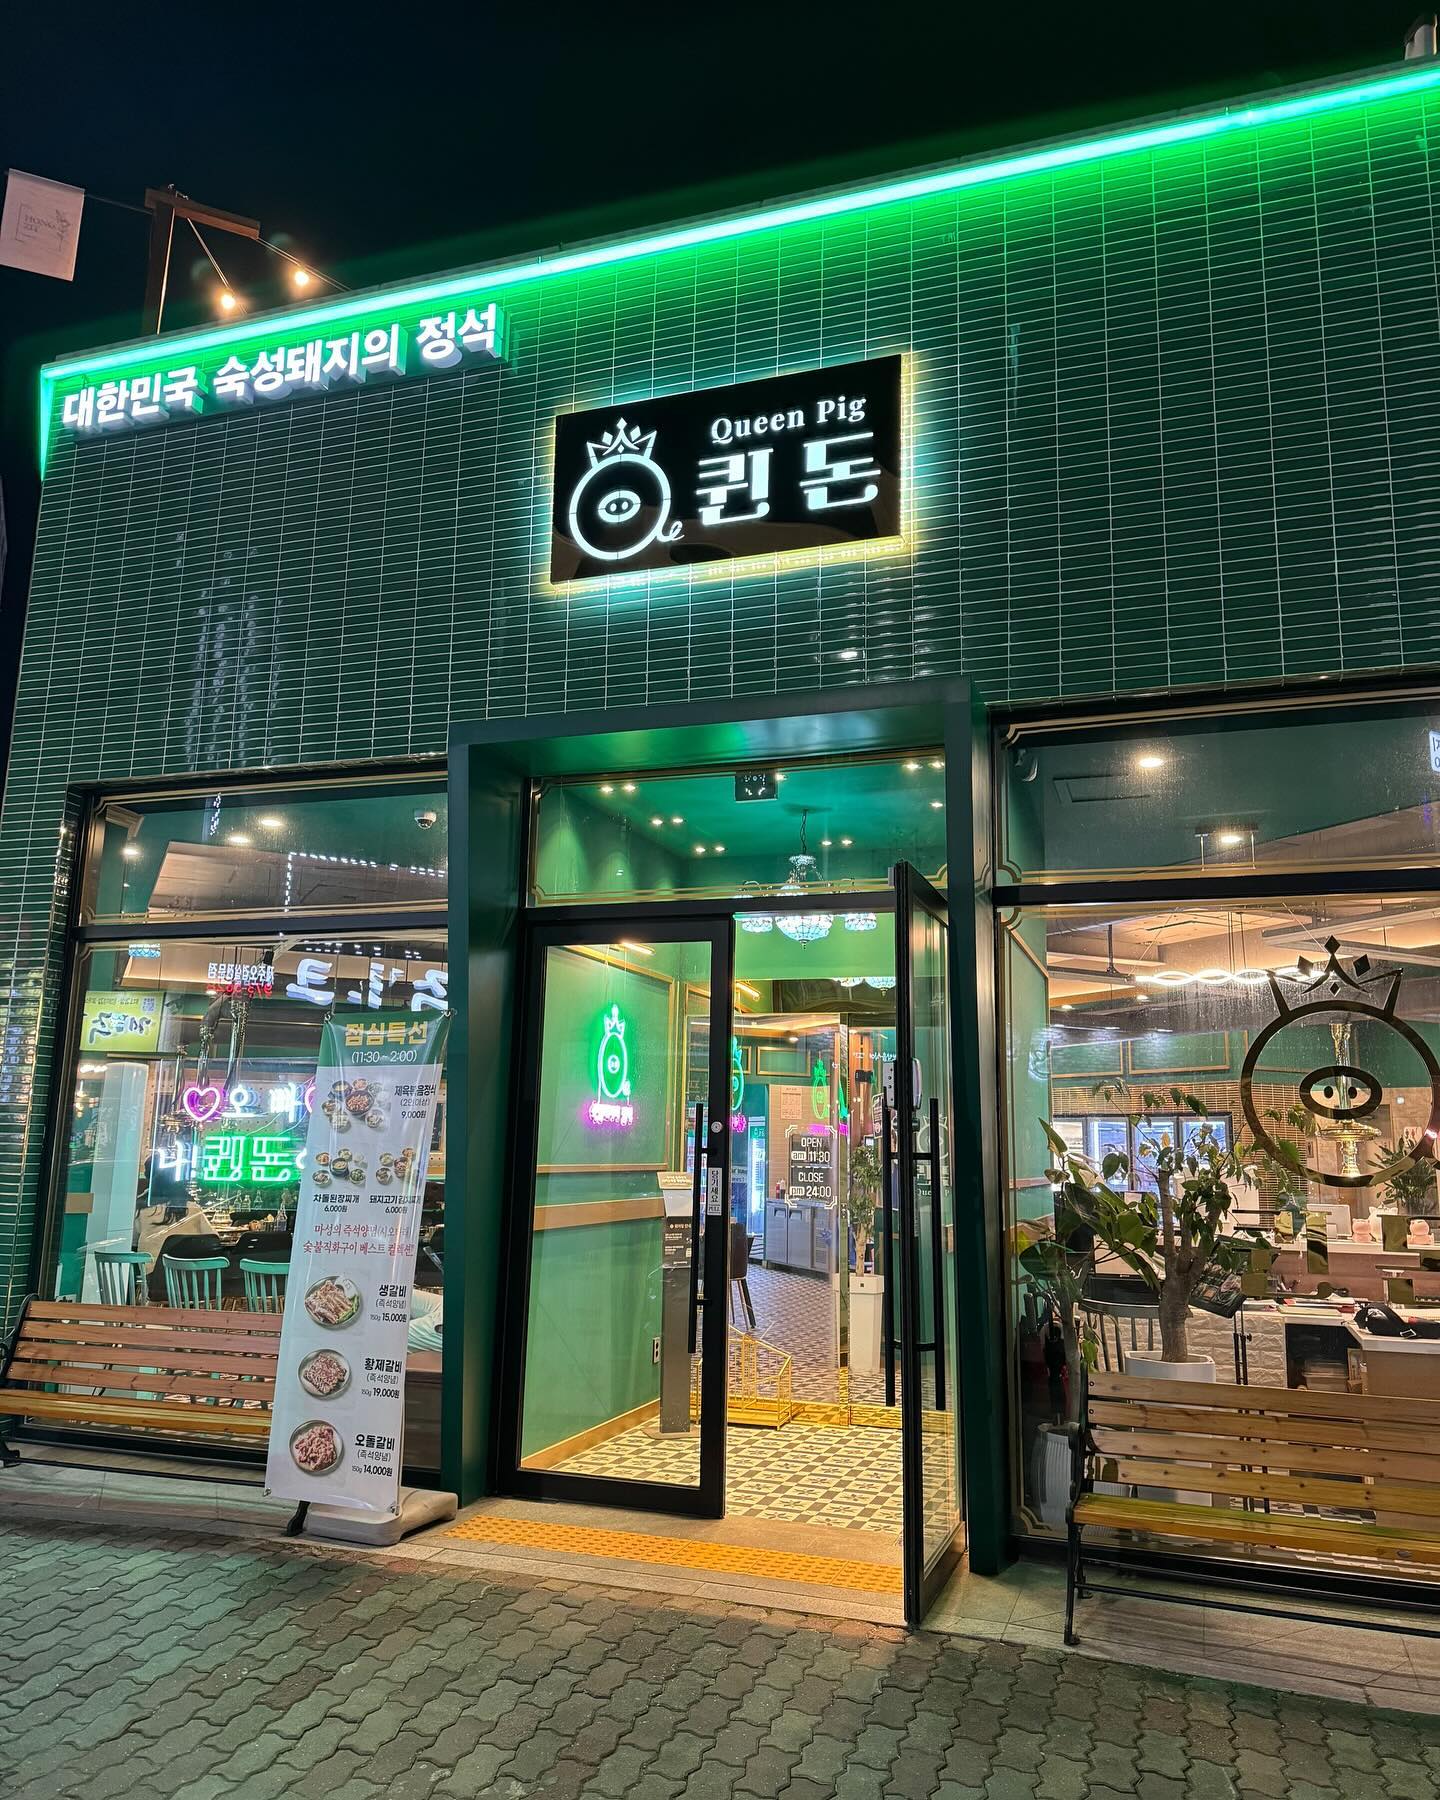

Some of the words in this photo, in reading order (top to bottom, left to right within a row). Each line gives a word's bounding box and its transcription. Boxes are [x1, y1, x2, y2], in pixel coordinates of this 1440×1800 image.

[63, 365, 199, 428] 대한민국
[213, 325, 401, 399] 숙성돼지의
[416, 303, 498, 361] 정석
[711, 407, 804, 444] Queen
[817, 396, 867, 423] Pig
[345, 1020, 428, 1046] 점심특선
[801, 1137, 823, 1148] OPEN
[808, 1150, 831, 1163] 11:30
[798, 1172, 824, 1183] CLOSE
[711, 1170, 719, 1203] 당기세요
[806, 1186, 832, 1198] 24:00
[324, 1205, 348, 1213] 6,000원
[379, 1284, 407, 1298] 생갈비
[364, 1357, 402, 1374] 황제갈비
[355, 1433, 395, 1451] 오돌갈비
